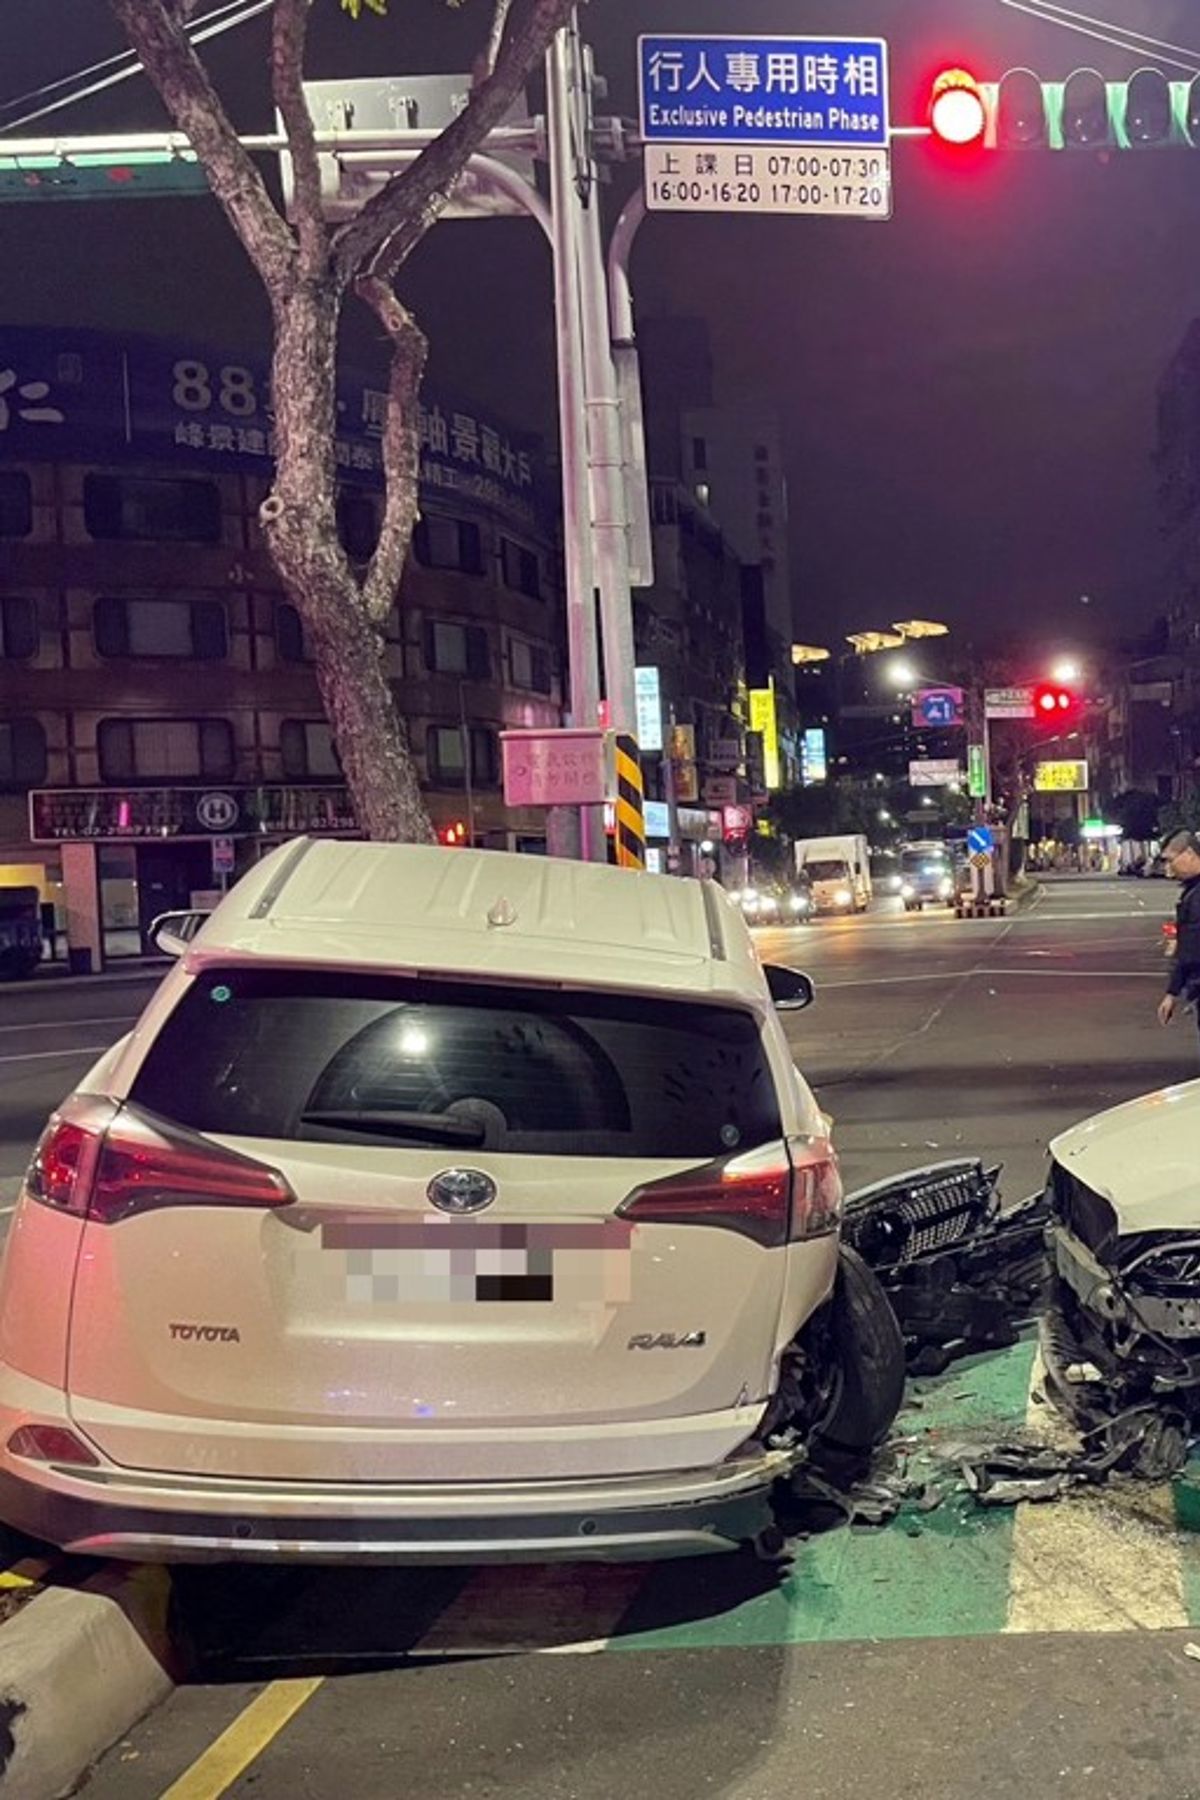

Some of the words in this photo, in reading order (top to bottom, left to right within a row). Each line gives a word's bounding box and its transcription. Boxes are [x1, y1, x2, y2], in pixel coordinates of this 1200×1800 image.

[649, 51, 878, 96] 行人專用時相
[649, 104, 728, 126] Exclusive
[733, 105, 824, 130] Pedestrian
[828, 107, 880, 131] Phase
[659, 152, 754, 176] 上課日
[768, 157, 880, 179] 07:00-07:30
[652, 181, 760, 203] 16:00-16:20
[772, 185, 882, 206] 17:00-17:20
[169, 1323, 240, 1344] TOYOTA
[627, 1331, 706, 1351] RAV4
